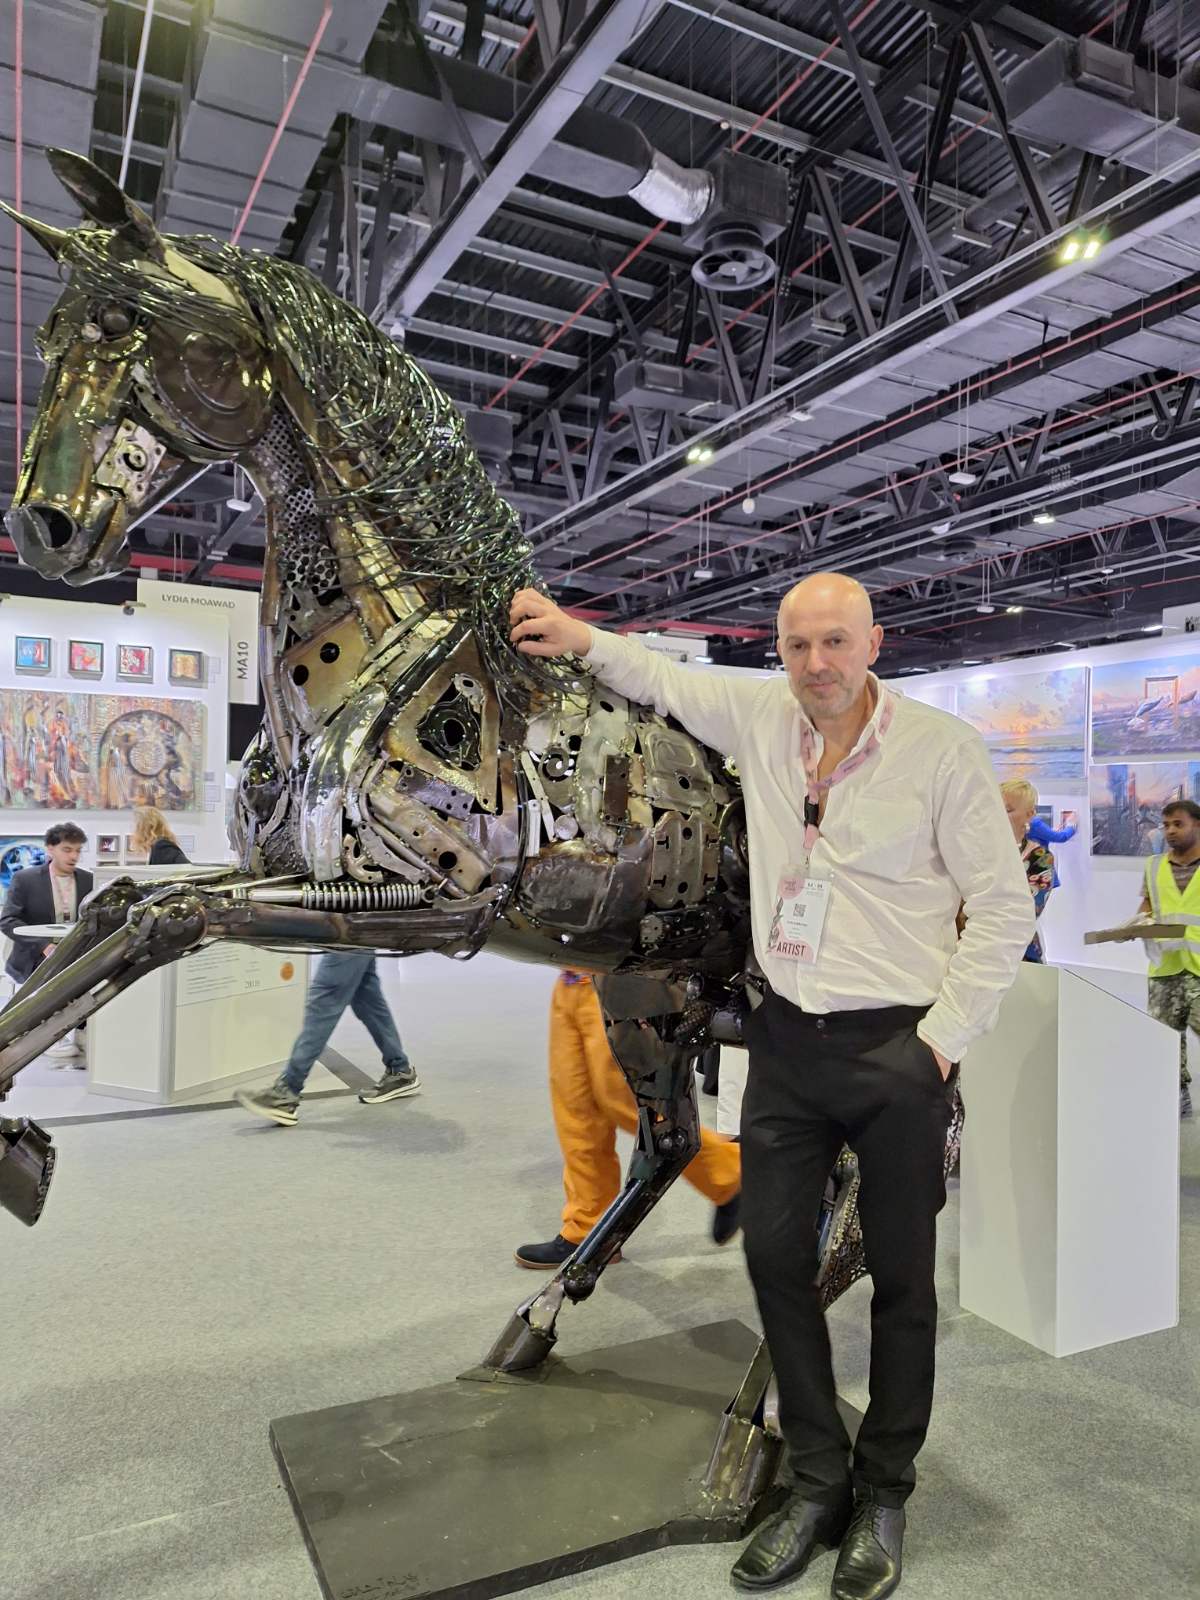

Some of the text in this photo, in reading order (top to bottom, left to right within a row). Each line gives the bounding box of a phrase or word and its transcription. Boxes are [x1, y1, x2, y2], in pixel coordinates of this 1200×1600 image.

[161, 594, 236, 609] LYDIA MOAWAD
[237, 641, 249, 680] MA10
[776, 941, 806, 957] ARTIST
